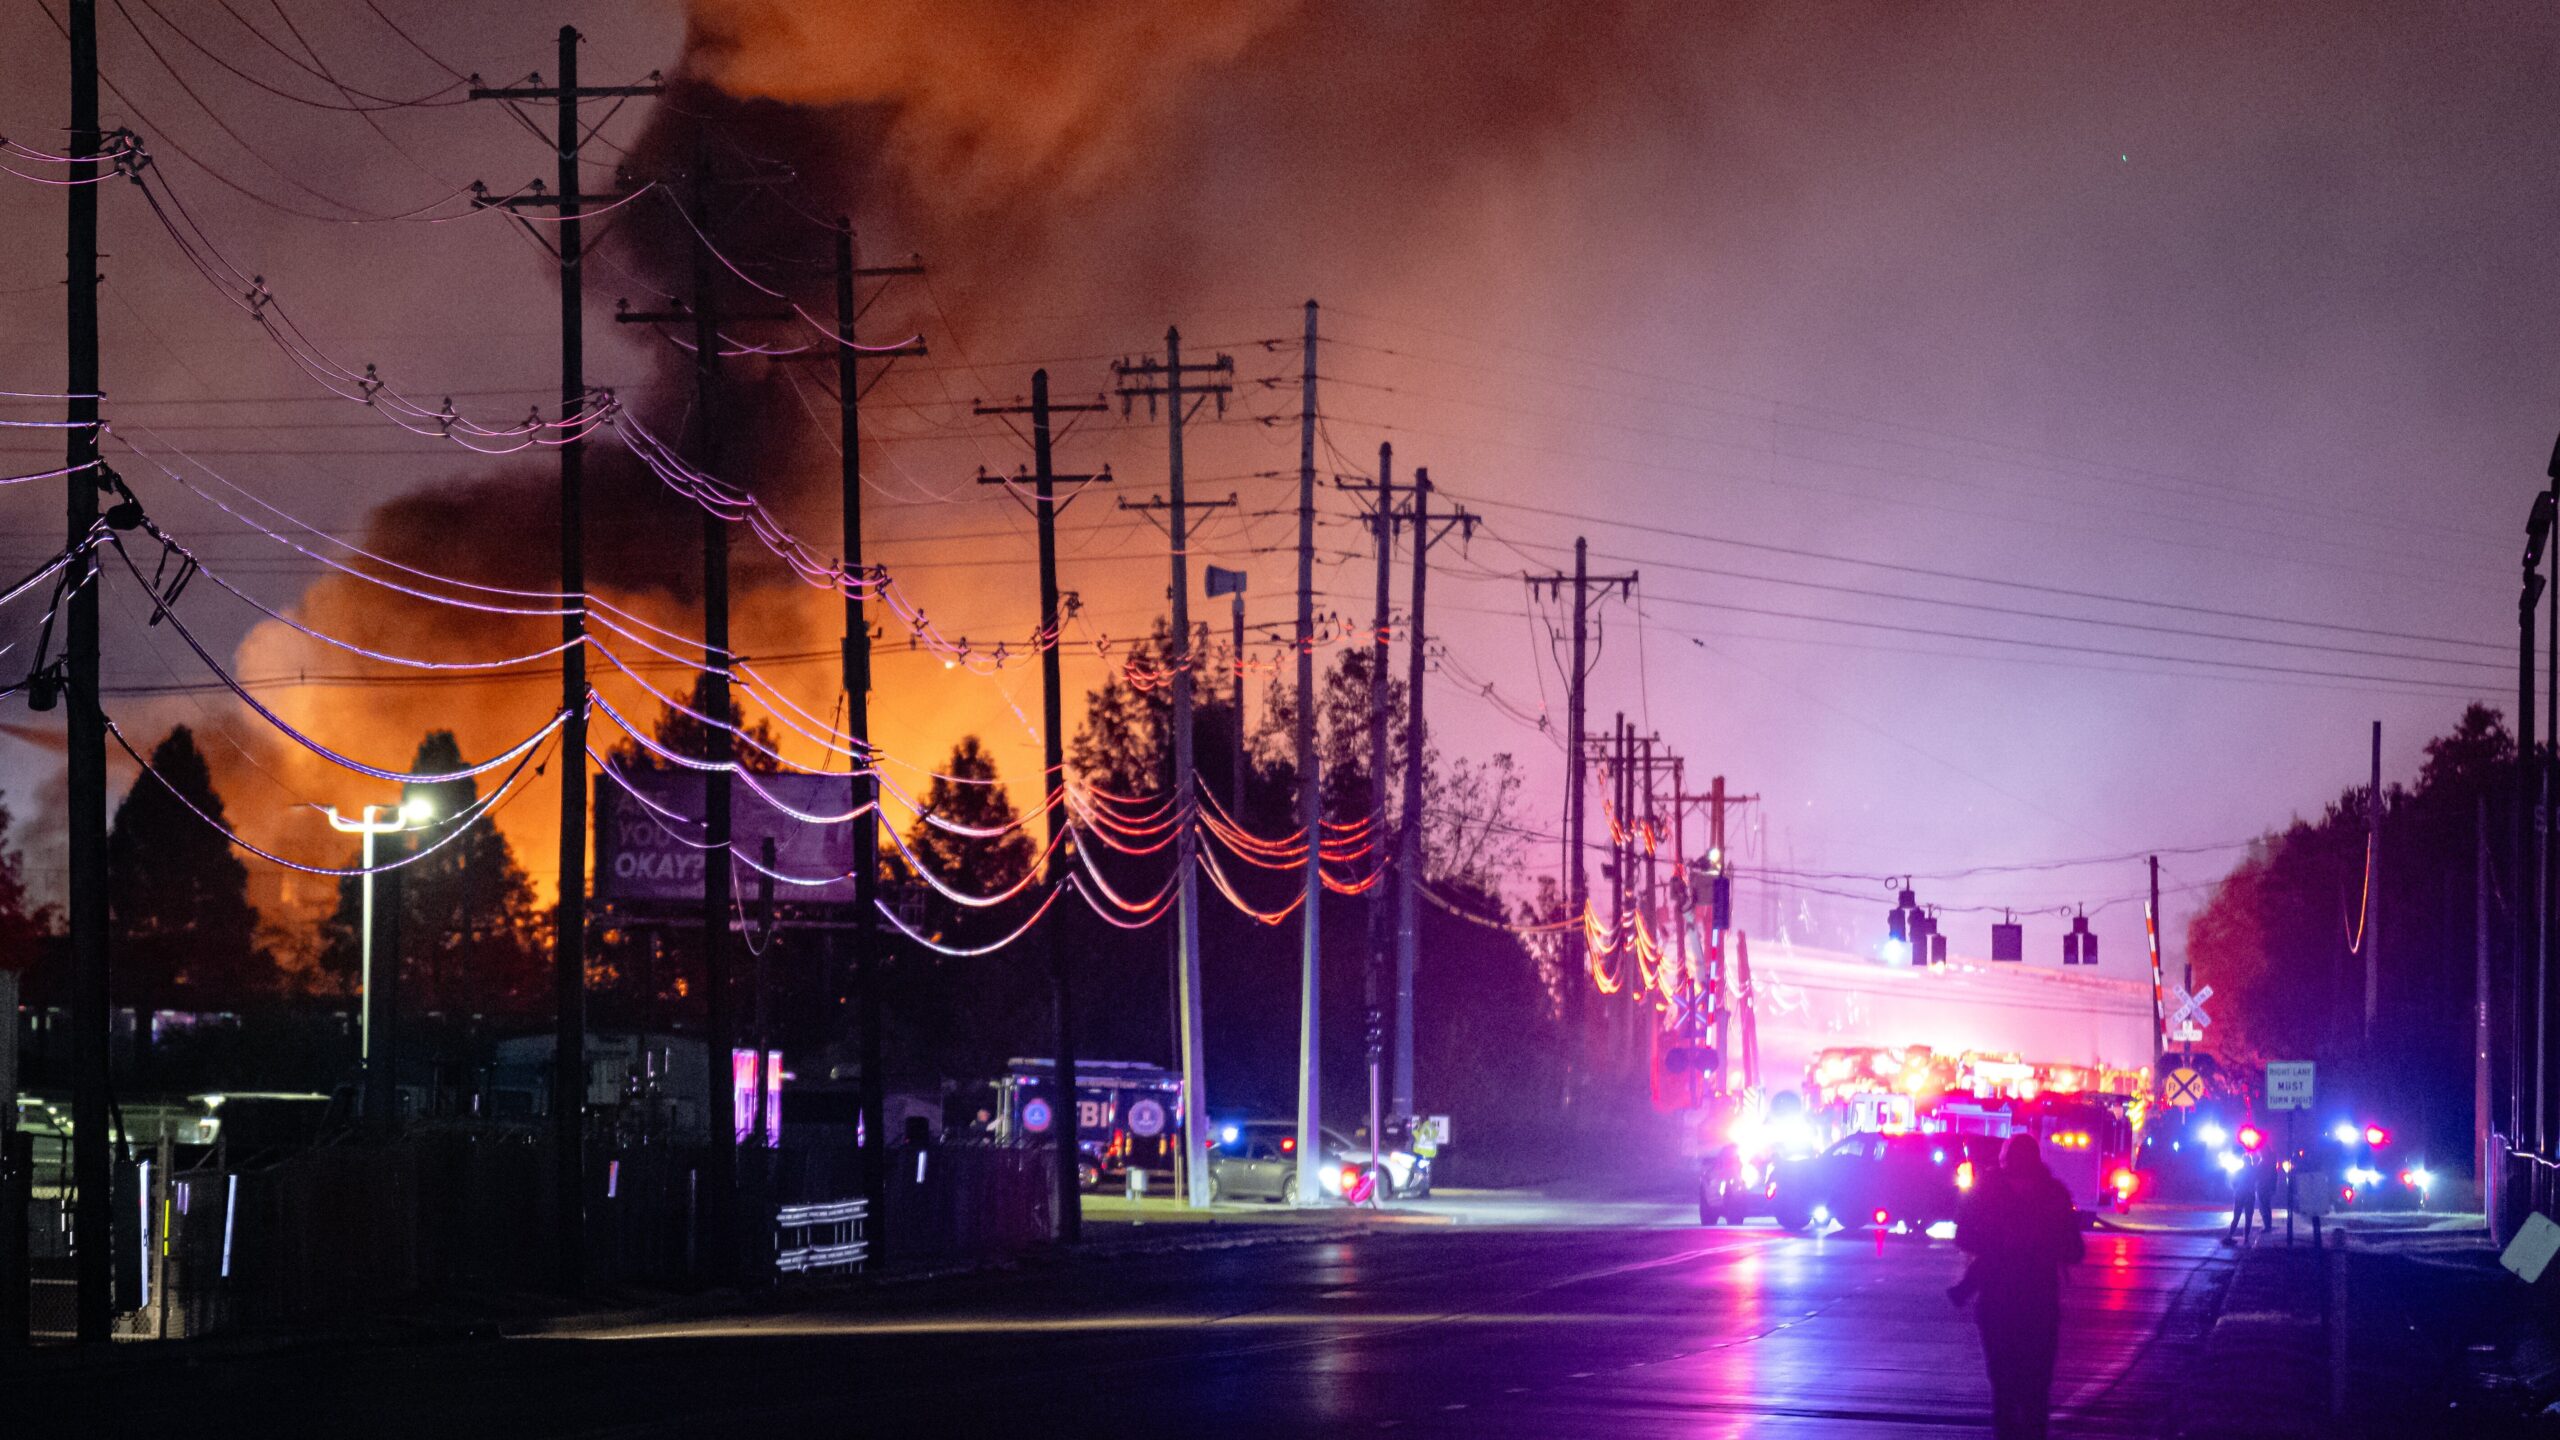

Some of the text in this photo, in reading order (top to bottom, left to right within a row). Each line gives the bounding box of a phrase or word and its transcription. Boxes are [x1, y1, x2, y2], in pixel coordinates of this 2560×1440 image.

[615, 851, 704, 879] OKAY?
[2269, 1068, 2311, 1076] RIGHT LANE
[2168, 1082, 2201, 1092] R R
[2277, 1081, 2303, 1091] MUST
[2269, 1096, 2288, 1104] TURN
